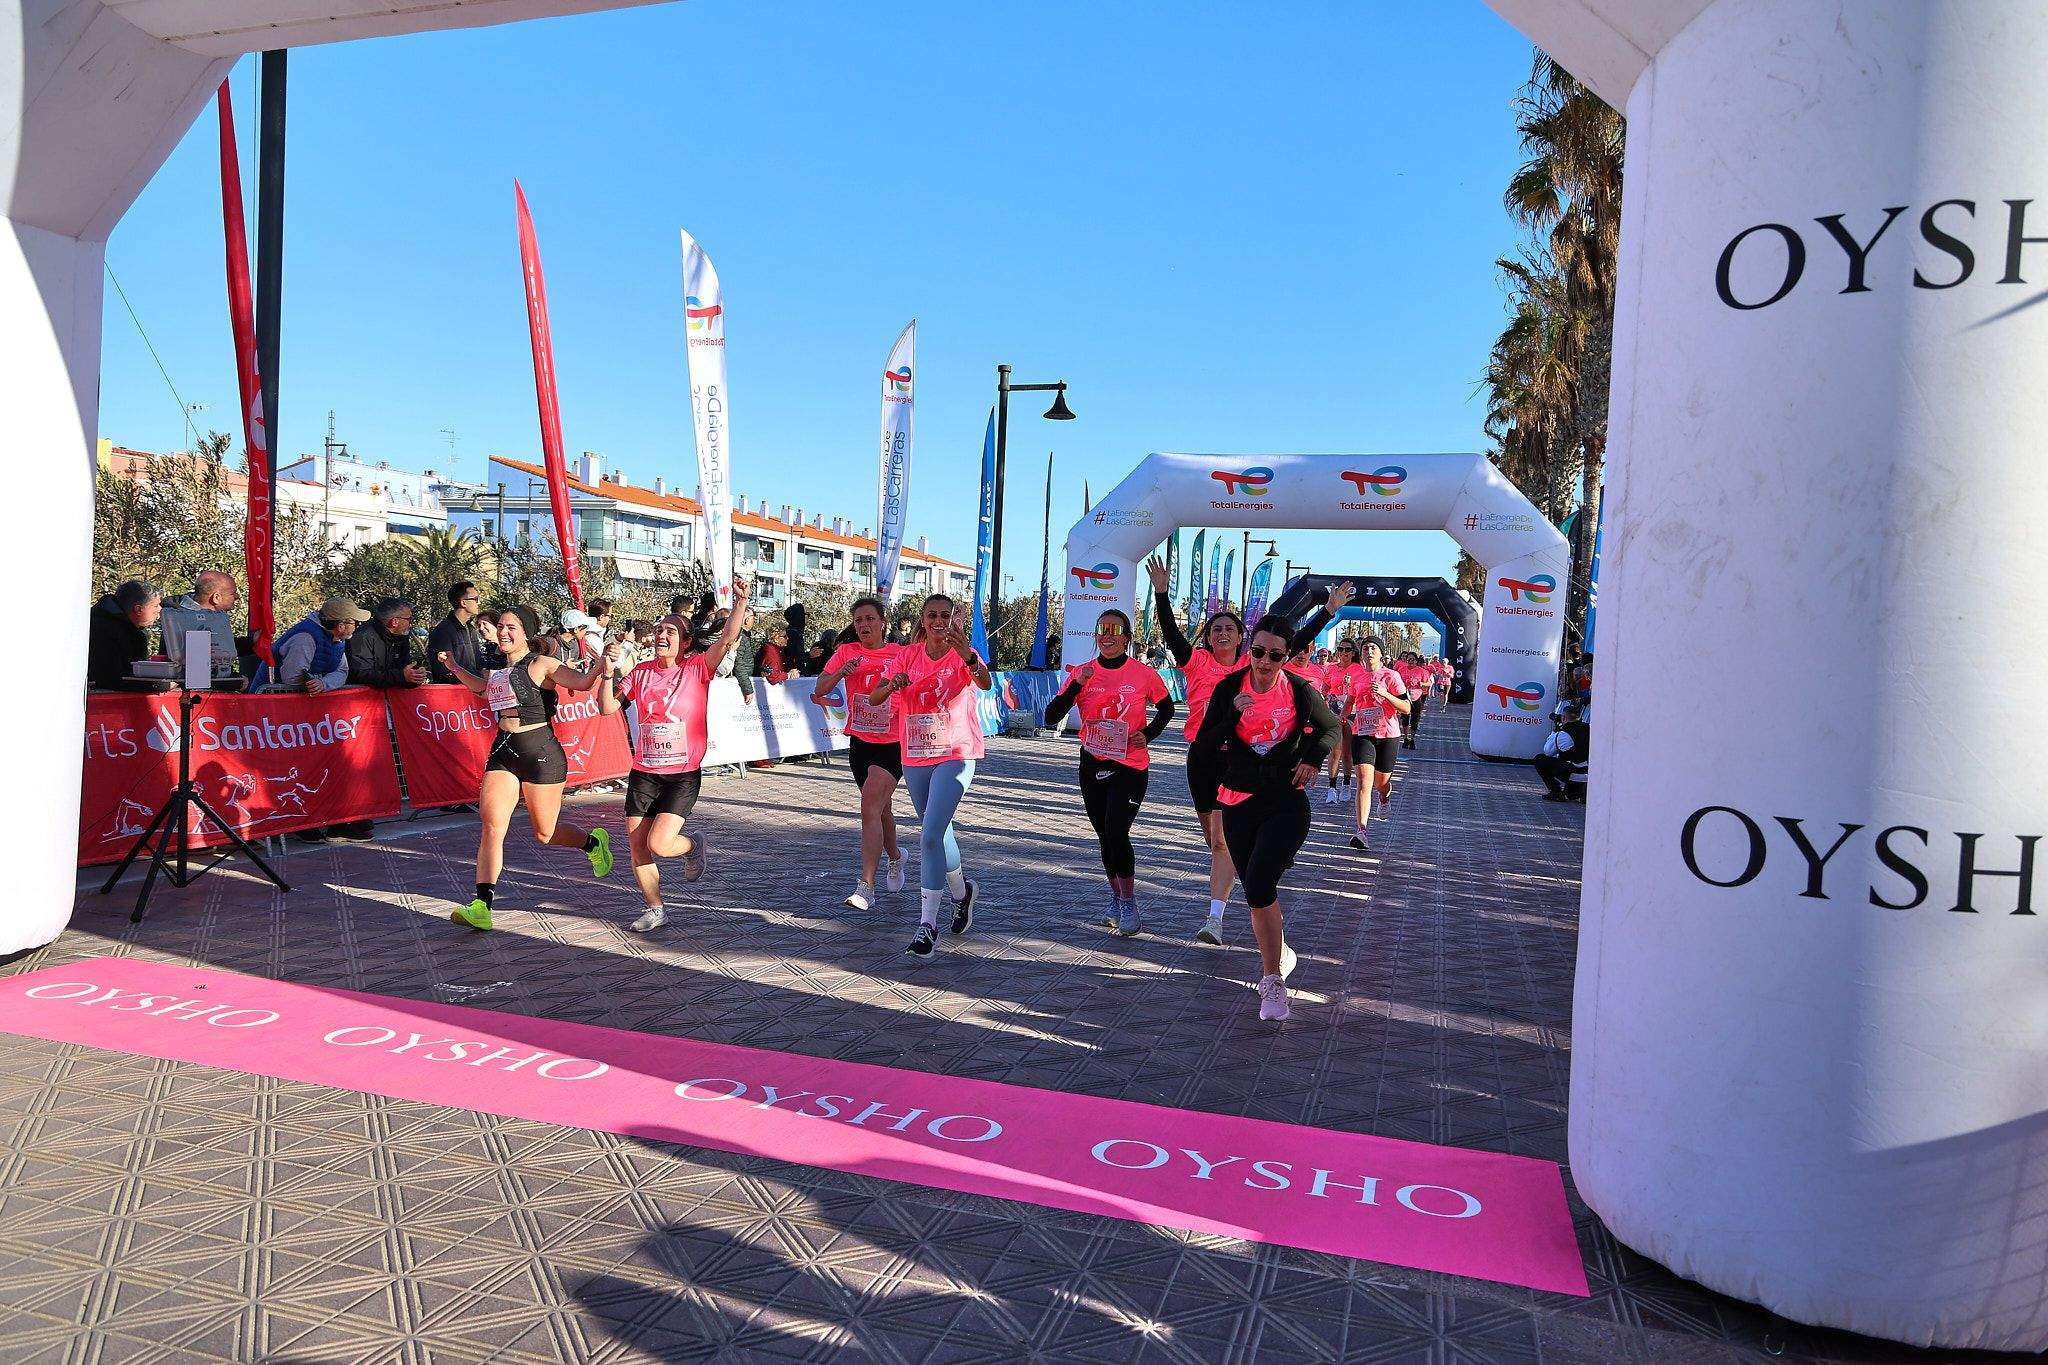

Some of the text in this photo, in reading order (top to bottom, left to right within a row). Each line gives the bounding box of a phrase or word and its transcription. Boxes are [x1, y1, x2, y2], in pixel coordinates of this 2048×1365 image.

[1714, 198, 2048, 311] OYSH
[1210, 501, 1274, 511] TotalEnergies
[1339, 501, 1407, 512] TotalEnergies
[1069, 593, 1118, 602] TotalEnergies
[1495, 606, 1554, 618] TotalEnergies
[1455, 624, 1466, 694] VOLVO
[1491, 646, 1550, 657] totalenergies.es
[85, 713, 363, 759] rts Santander
[415, 700, 492, 740] Sports
[919, 732, 937, 741] 016
[1484, 713, 1543, 725] TotalEnergies
[654, 741, 672, 750] 016
[1680, 805, 2044, 916] OYSH
[24, 981, 280, 1029] OYSHO
[323, 1026, 610, 1081] OYSHO
[673, 1077, 1003, 1143] OYSHO
[1090, 1139, 1483, 1219] OYSHO
